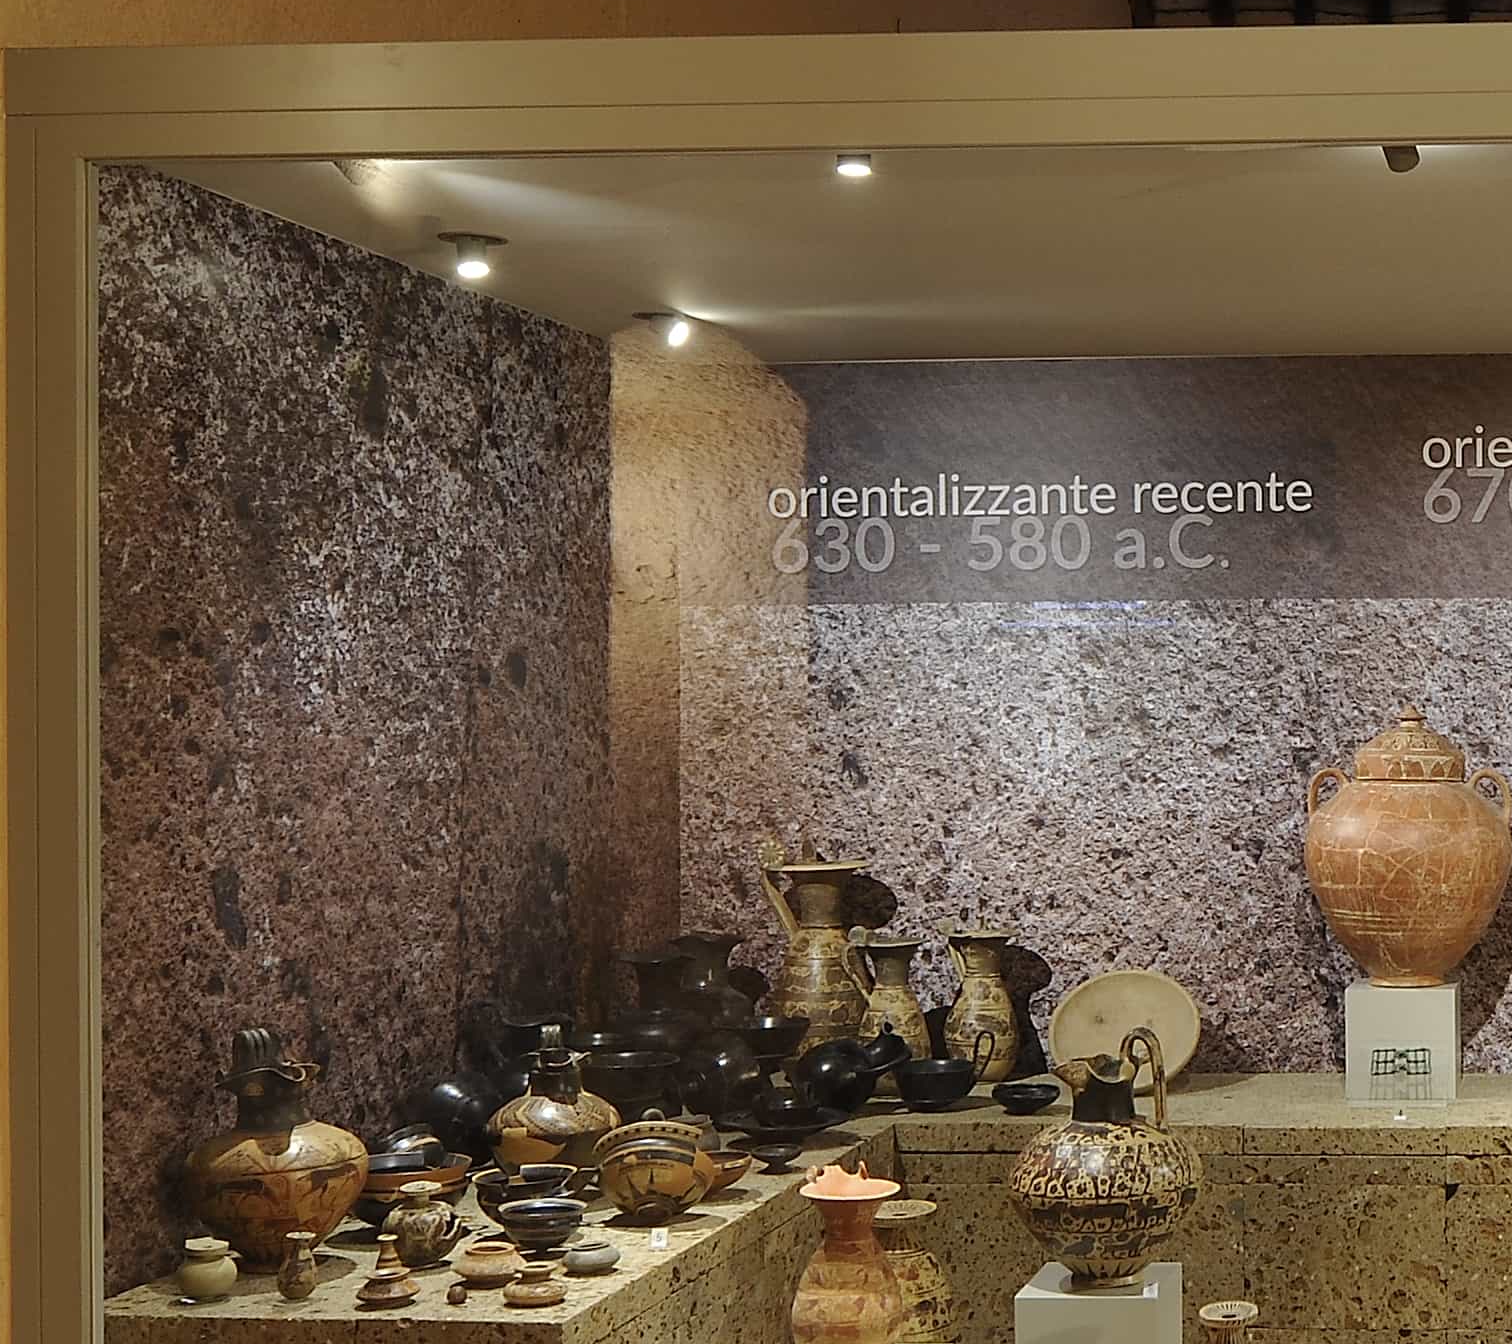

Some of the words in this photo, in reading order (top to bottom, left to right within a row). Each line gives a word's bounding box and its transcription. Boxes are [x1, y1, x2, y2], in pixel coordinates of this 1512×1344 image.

[767, 473, 1116, 519] orientalizzante
[1133, 472, 1313, 514] recente
[772, 517, 895, 574] 630
[919, 542, 942, 553] -
[967, 515, 1091, 572] 580
[1113, 514, 1230, 570] a.C.
